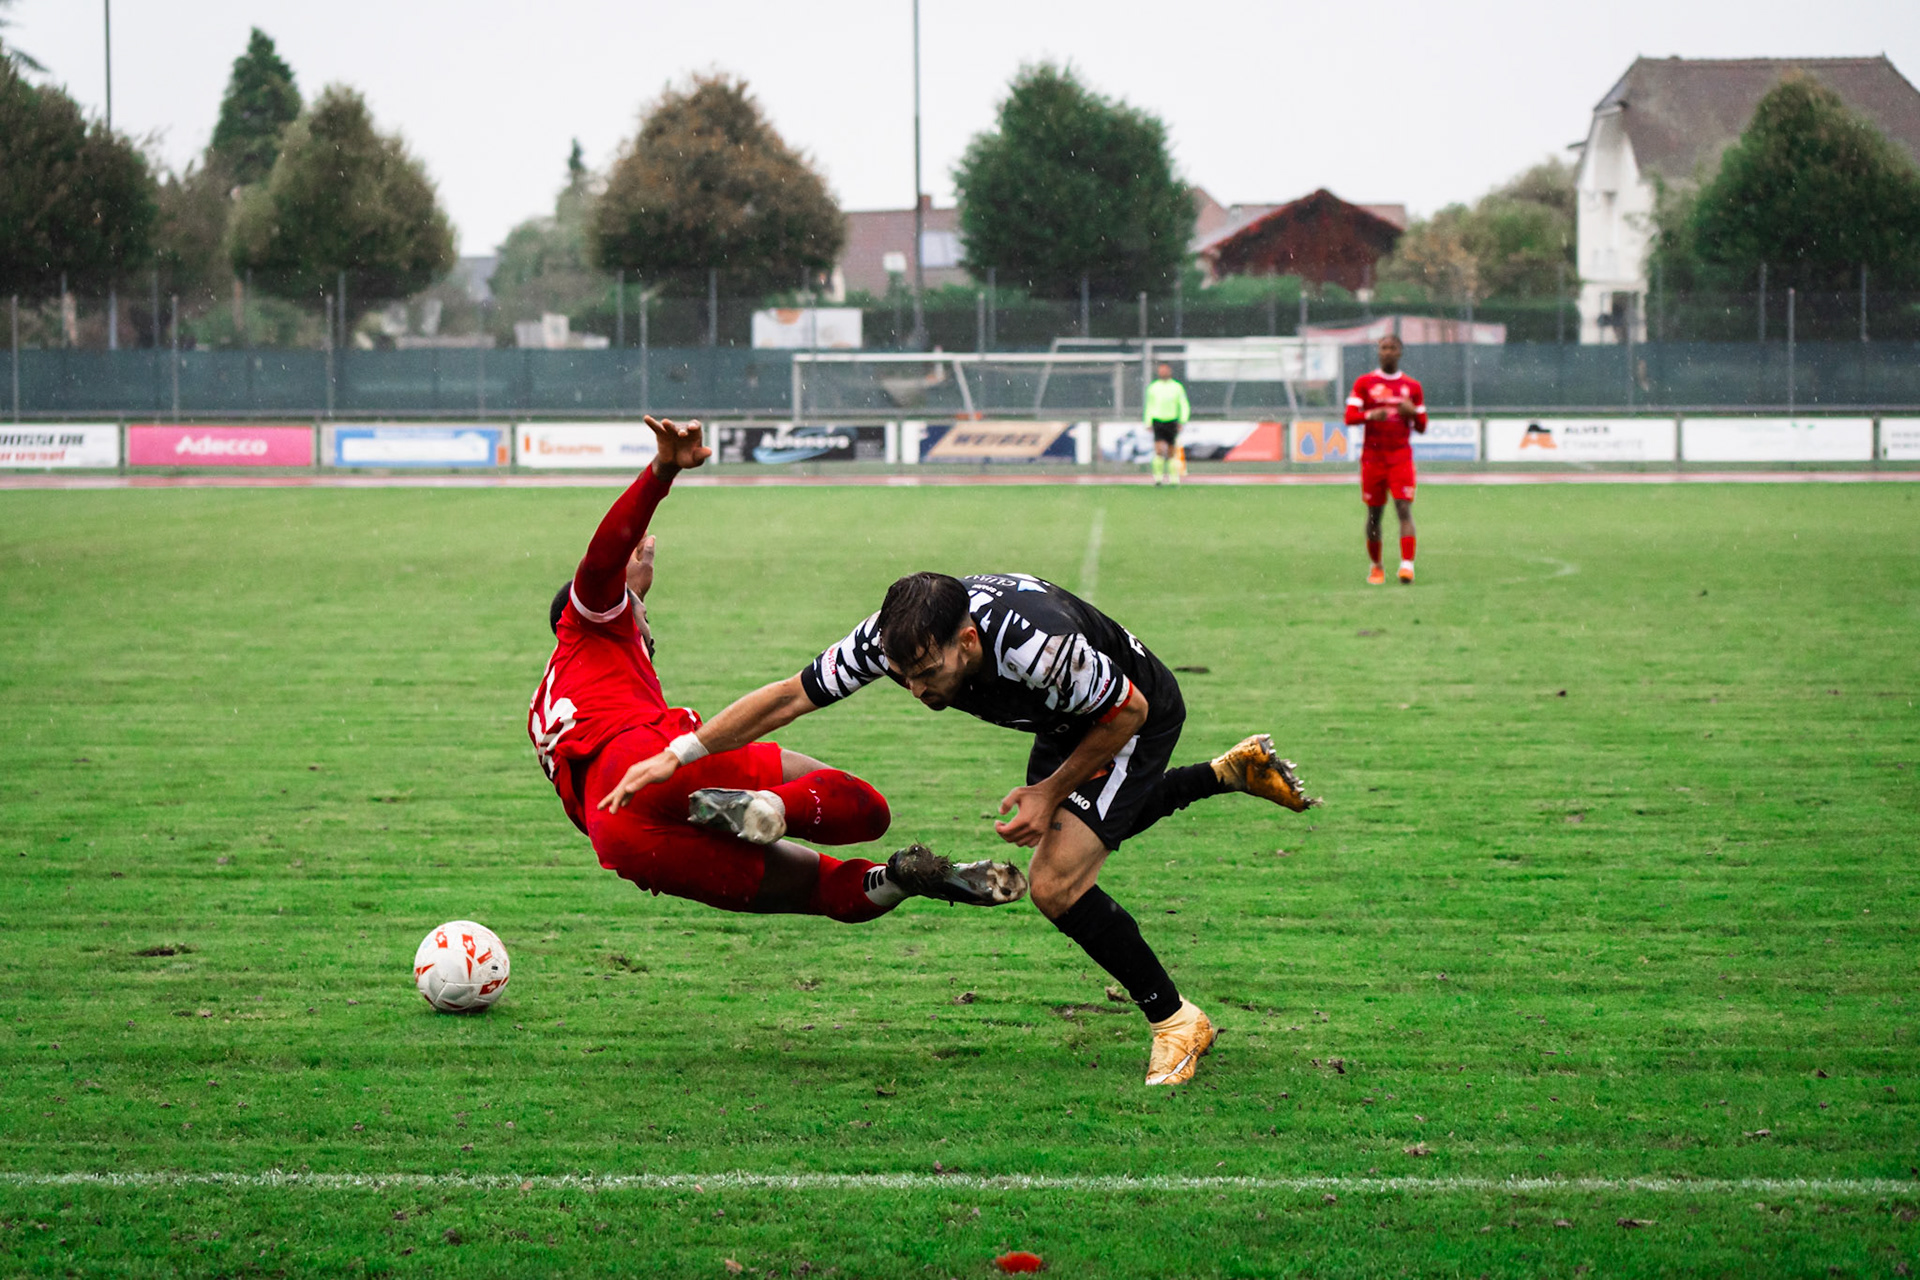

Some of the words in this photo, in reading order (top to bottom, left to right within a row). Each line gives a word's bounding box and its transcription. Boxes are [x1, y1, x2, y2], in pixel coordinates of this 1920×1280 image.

[175, 435, 268, 456] Adecco
[808, 788, 821, 825] JAKO
[1067, 791, 1091, 811] AKO
